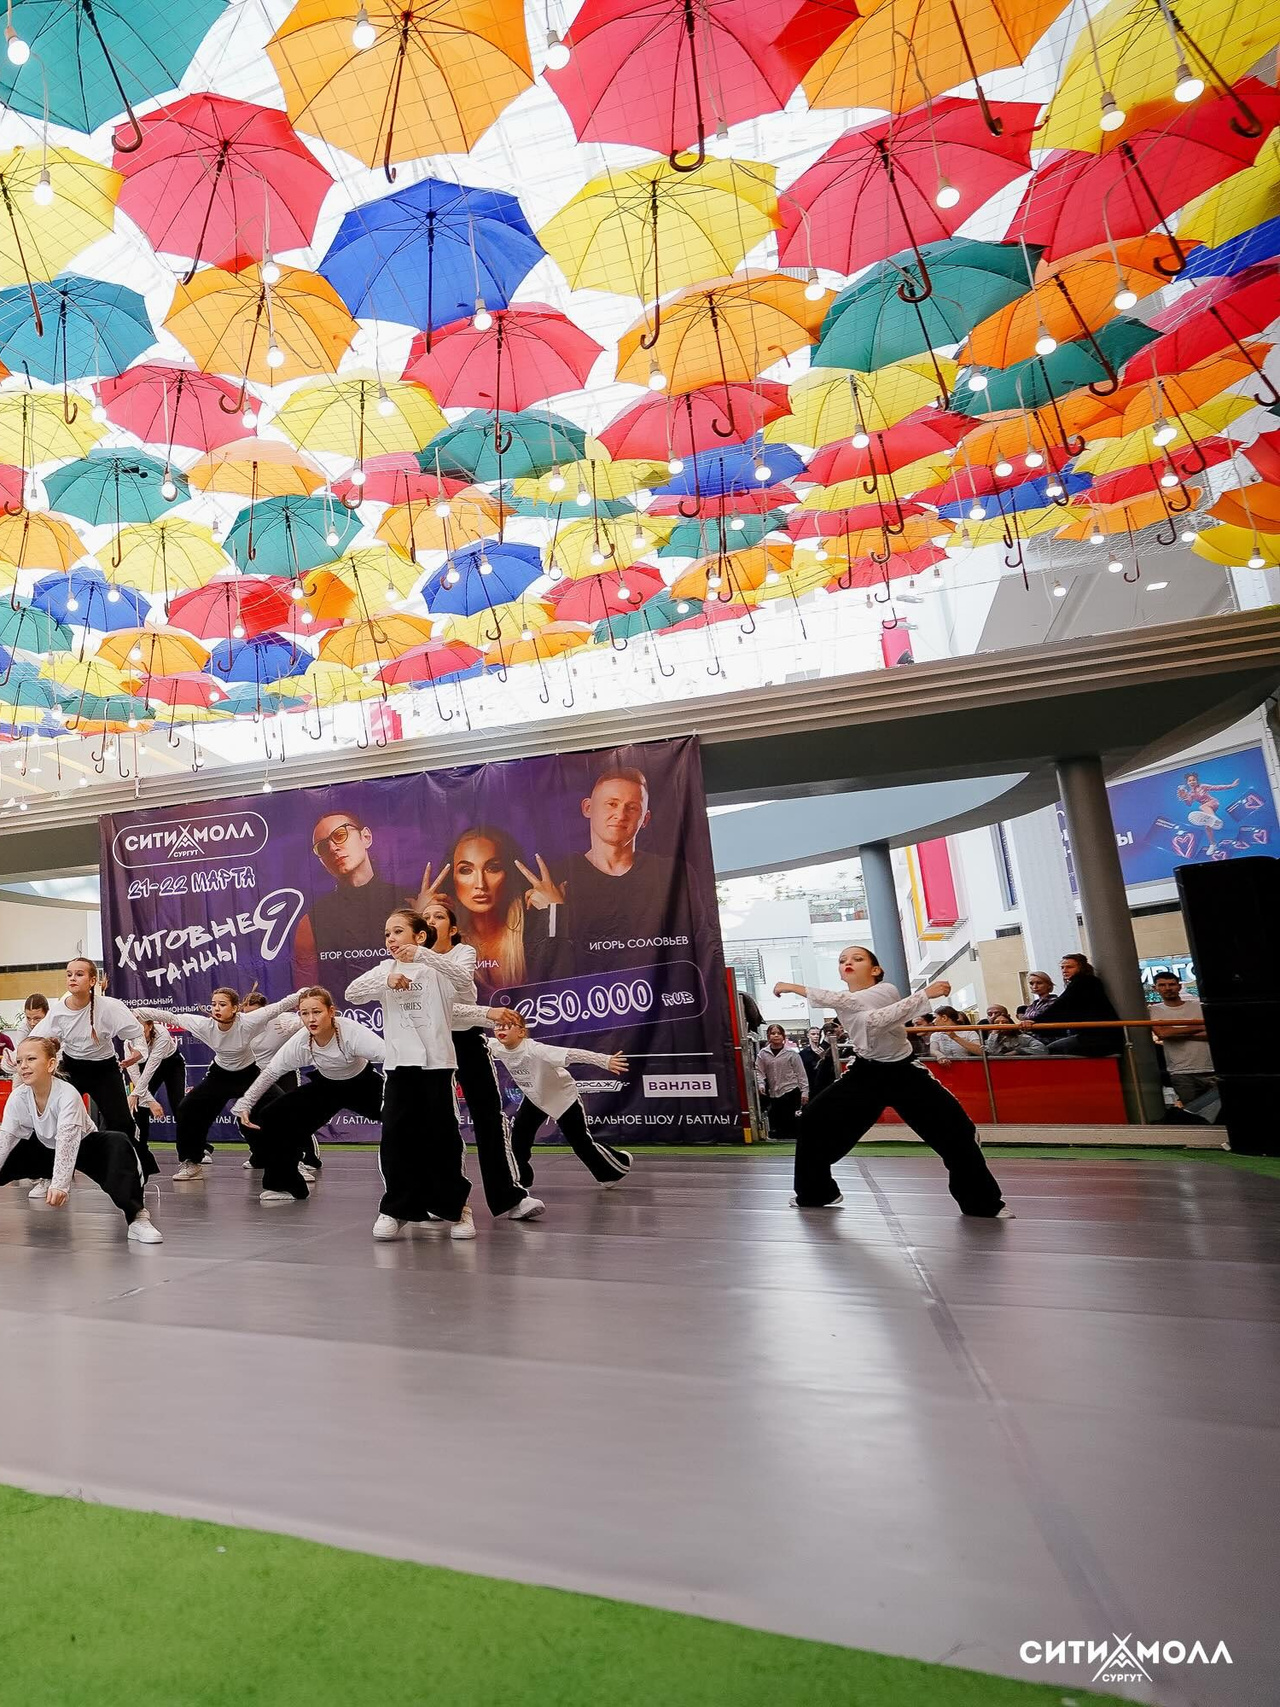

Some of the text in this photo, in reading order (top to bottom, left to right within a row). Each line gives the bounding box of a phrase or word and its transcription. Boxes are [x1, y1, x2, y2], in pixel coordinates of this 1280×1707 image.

[173, 849, 199, 858] СУРГУТ
[128, 866, 256, 899] 21-22 МАРТА
[589, 936, 689, 950] ИГОРЬ СОЛОВЬЕВ
[320, 951, 342, 960] ЕГОР
[474, 960, 499, 969] ИНА
[120, 995, 173, 1007] енеральный
[515, 979, 694, 1028] 250.000 RUB
[648, 1080, 712, 1091] ванлав
[584, 1115, 642, 1125] ВАЛЬНОЕ
[644, 1115, 674, 1125] ШОУ
[686, 1115, 730, 1125] БАТТЛЫ
